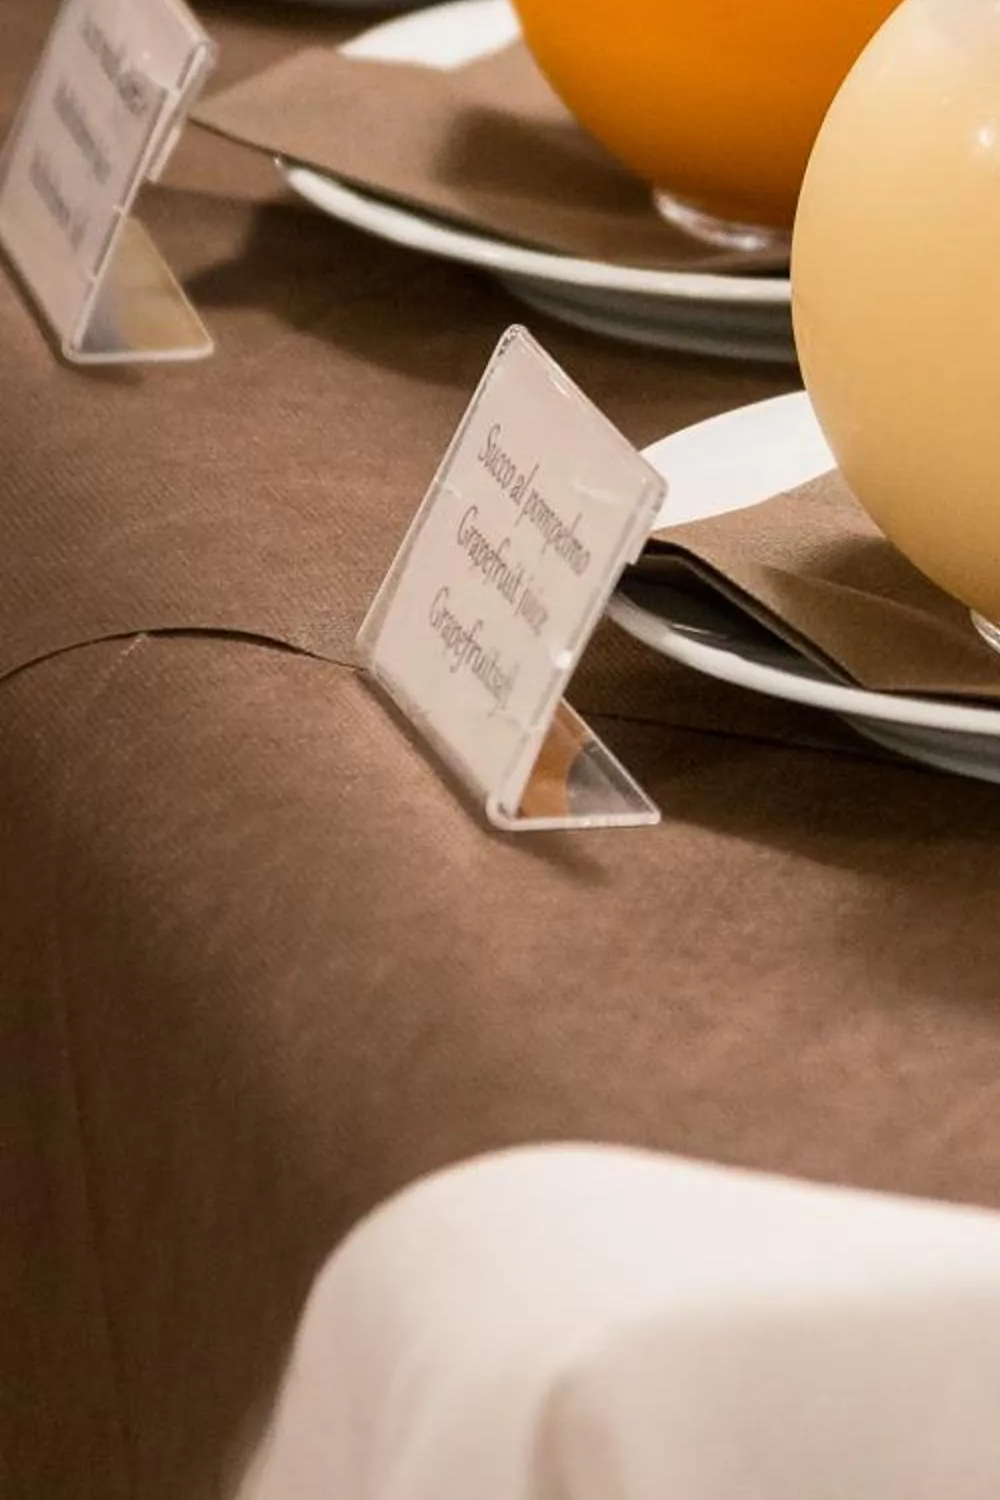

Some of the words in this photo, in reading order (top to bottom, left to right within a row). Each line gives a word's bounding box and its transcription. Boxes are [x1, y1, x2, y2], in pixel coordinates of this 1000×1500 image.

[478, 423, 518, 490] Succo
[509, 462, 541, 505] al
[457, 505, 525, 594] Grapefruit
